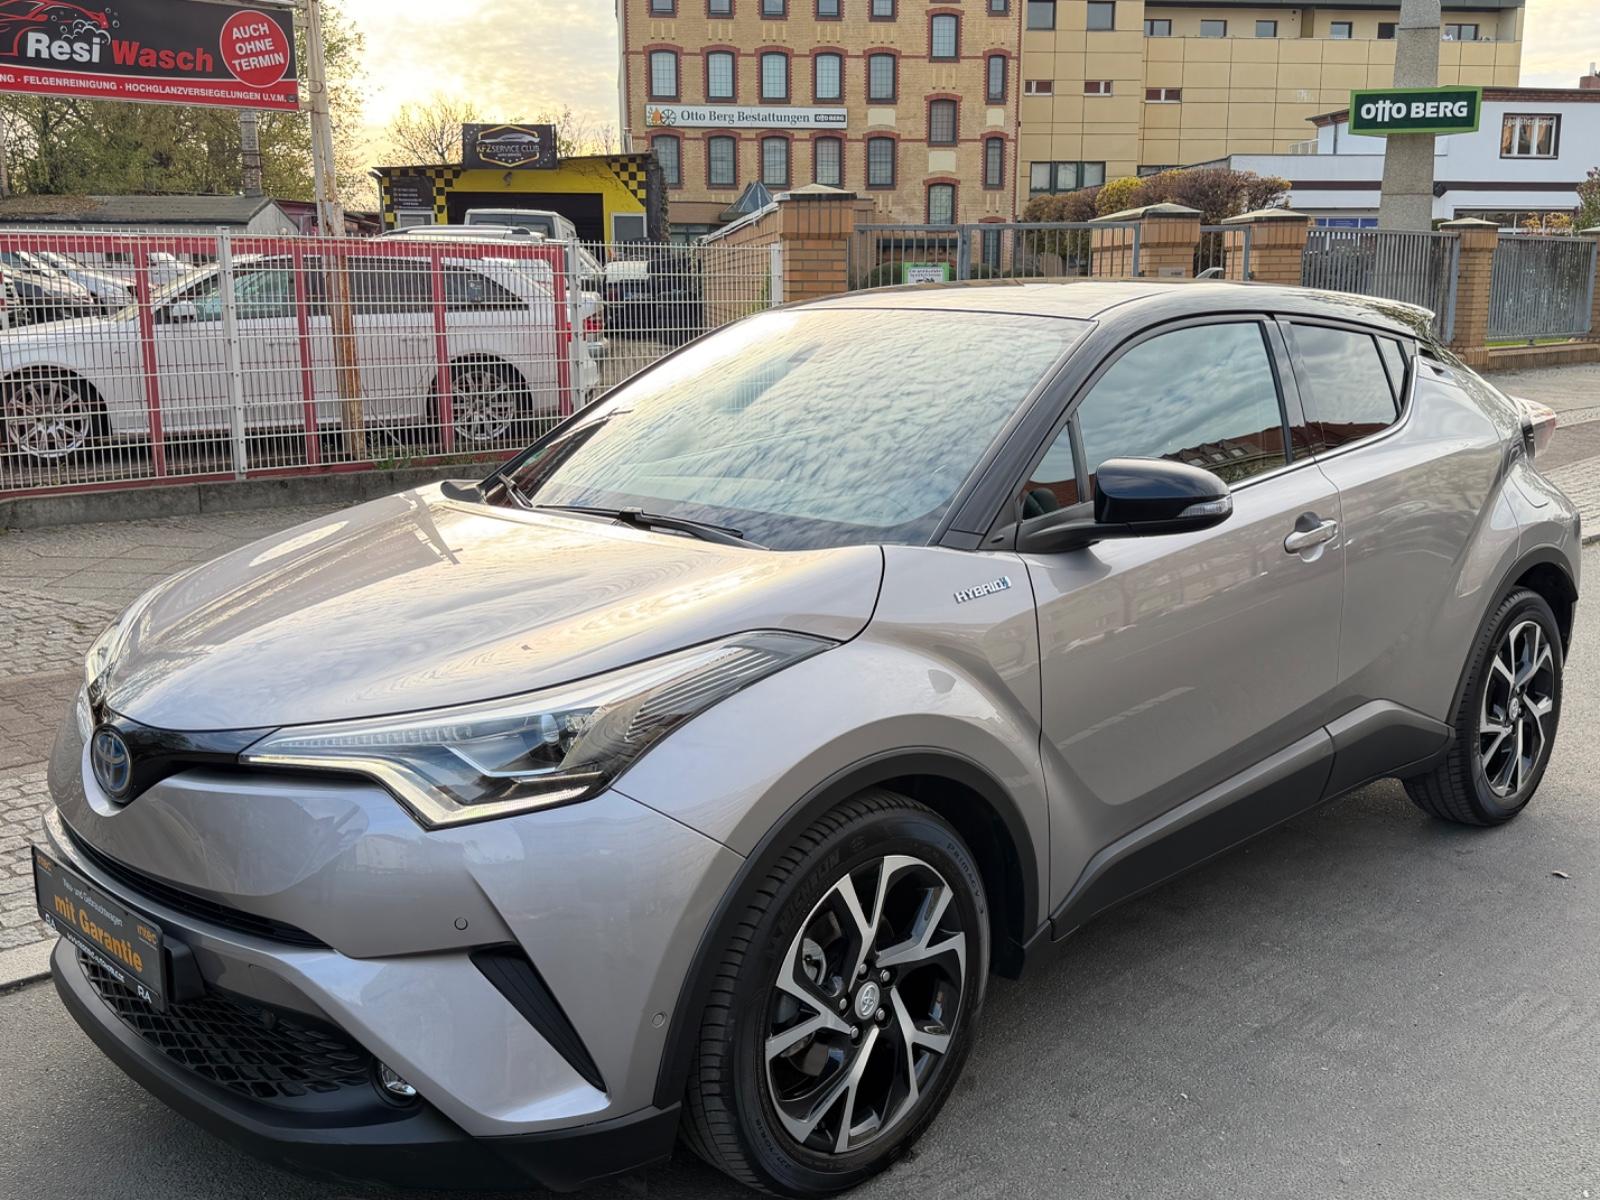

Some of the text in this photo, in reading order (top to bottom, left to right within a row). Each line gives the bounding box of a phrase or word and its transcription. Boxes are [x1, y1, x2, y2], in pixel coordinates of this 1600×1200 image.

[231, 22, 270, 40] AUCH
[27, 32, 213, 72] Resi Wasch
[235, 38, 275, 56] OHNE
[232, 52, 285, 72] TERMIN
[23, 75, 117, 90] FELGENREINIGUNG
[125, 83, 261, 101] HOCHGLANZVERSIEGELUNGEN
[680, 110, 810, 126] Otto Berg Bestattungen
[1410, 101, 1468, 118] BERG
[954, 577, 1009, 603] HYBRID
[54, 894, 77, 926] mit
[79, 908, 144, 974] Garantie
